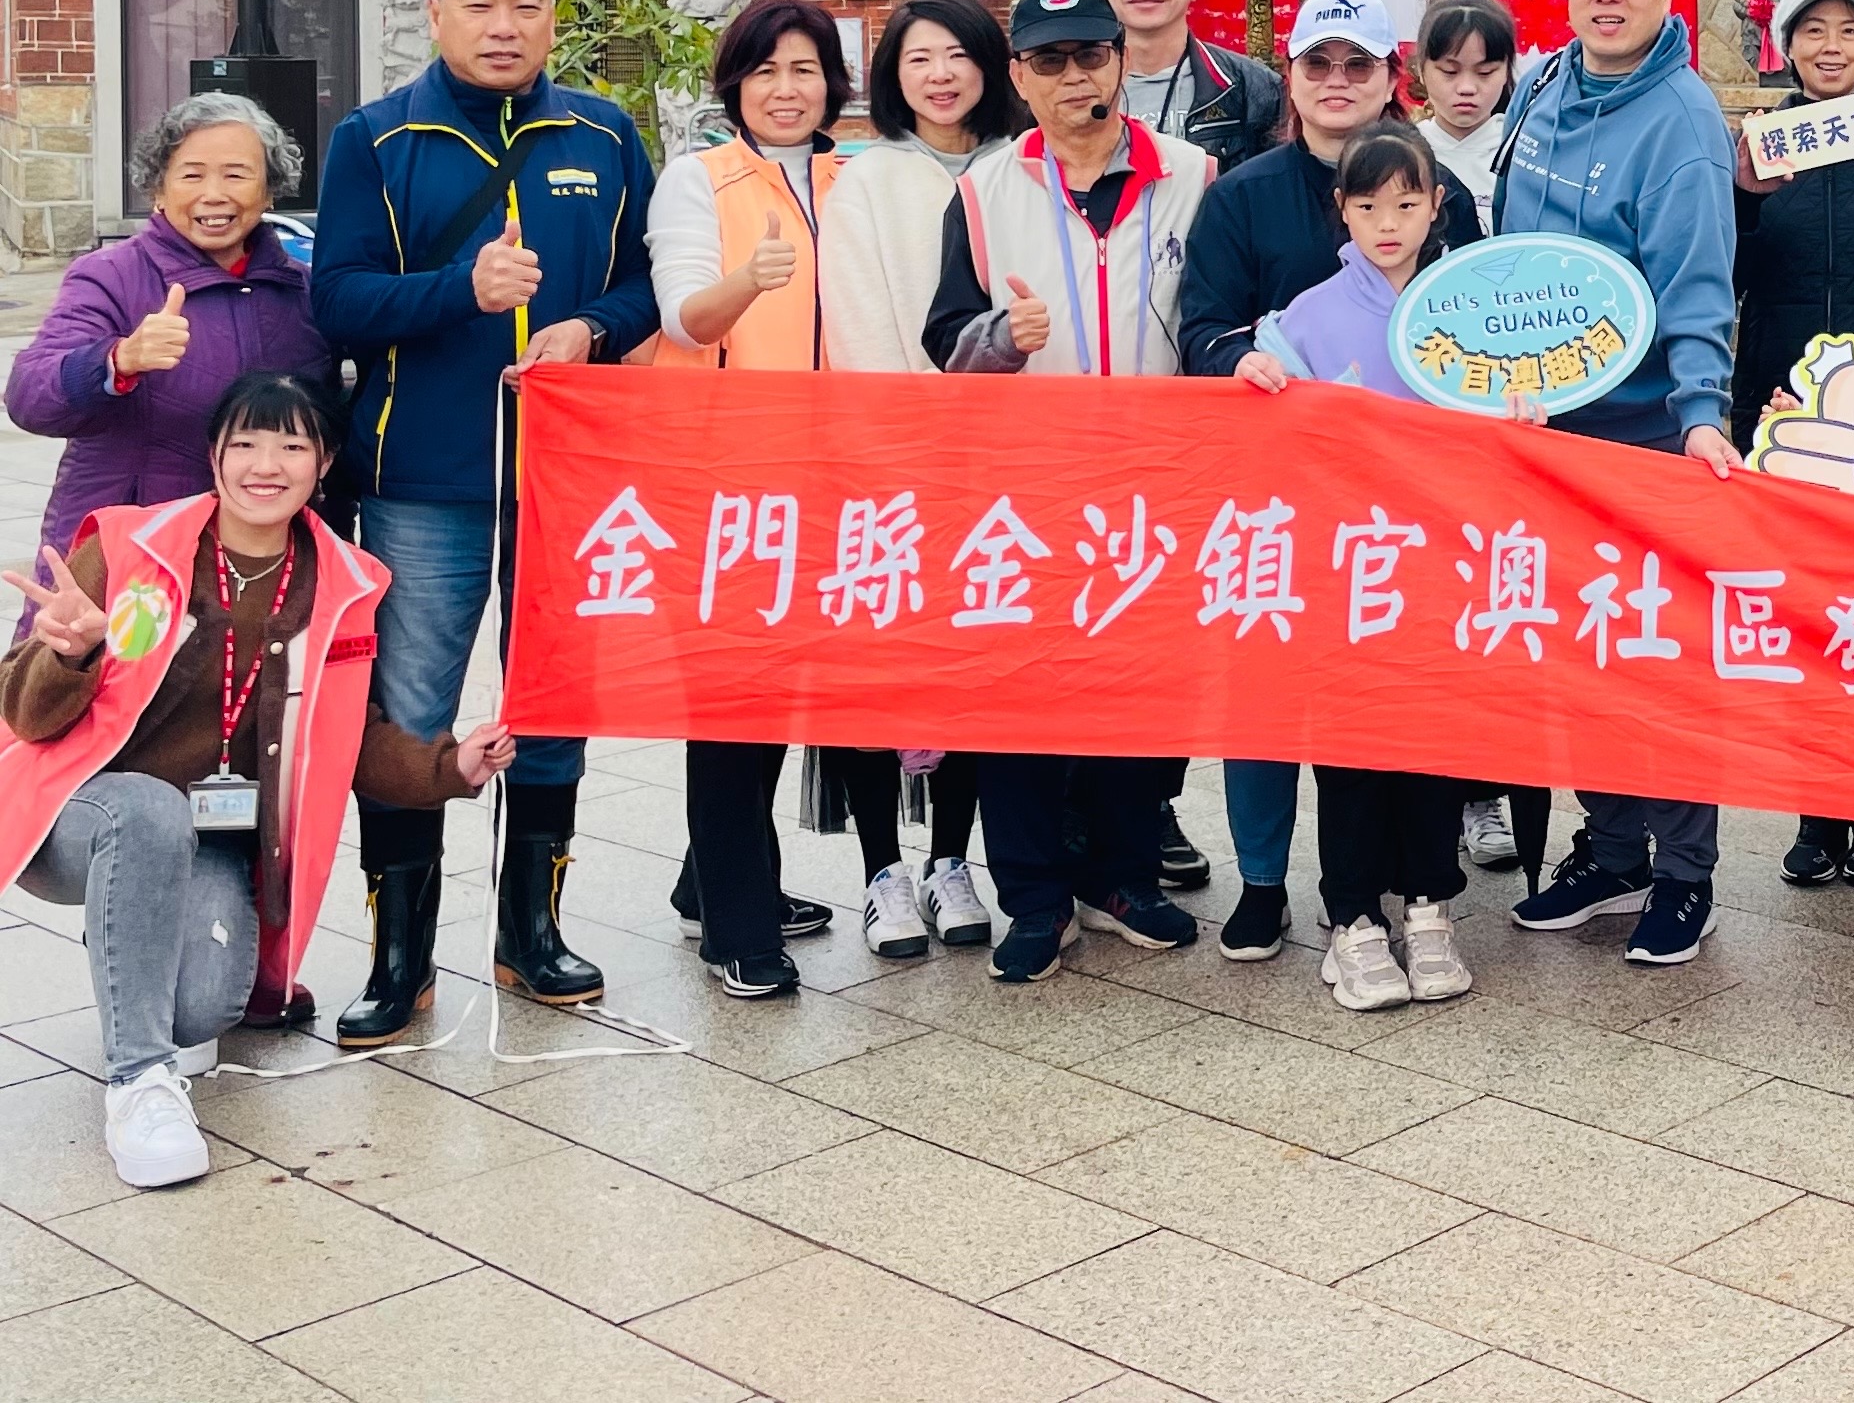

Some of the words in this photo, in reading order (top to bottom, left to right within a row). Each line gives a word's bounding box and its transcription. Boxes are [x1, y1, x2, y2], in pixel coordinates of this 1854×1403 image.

[1315, 8, 1352, 23] PUMA
[1427, 292, 1480, 315] Let's
[1493, 283, 1552, 306] travel
[1558, 282, 1579, 299] to
[1485, 305, 1589, 335] GUANAO
